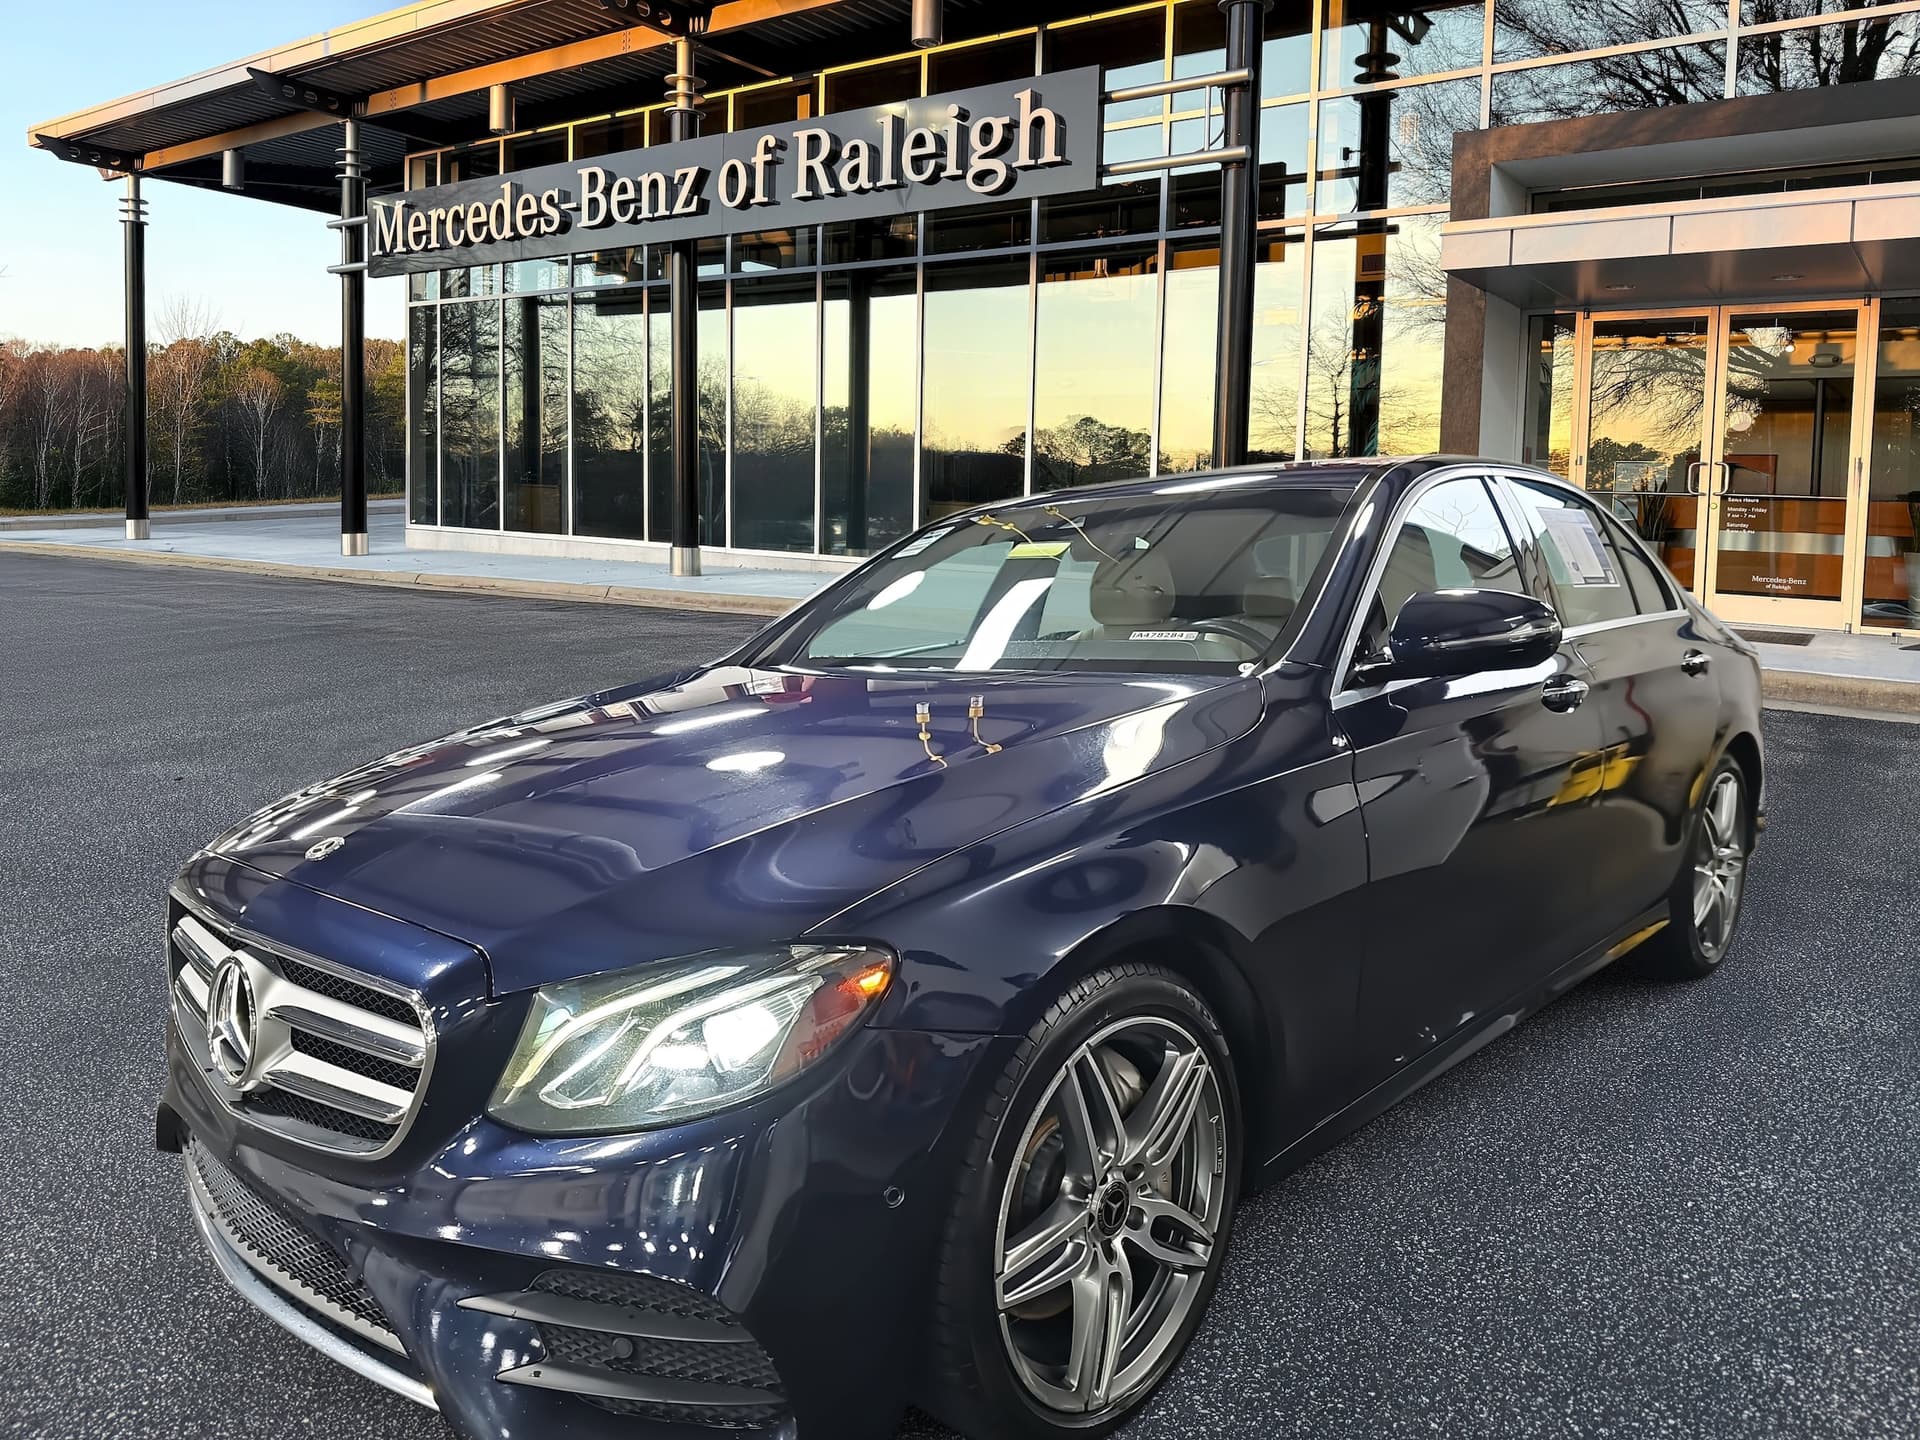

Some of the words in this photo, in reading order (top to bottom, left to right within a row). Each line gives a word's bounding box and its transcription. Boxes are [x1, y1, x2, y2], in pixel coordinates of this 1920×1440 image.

[371, 165, 702, 256] Mercedes-Benz
[717, 134, 779, 208] of
[792, 87, 1065, 200] Raleigh
[1752, 575, 1807, 584] Mercedes-Benz
